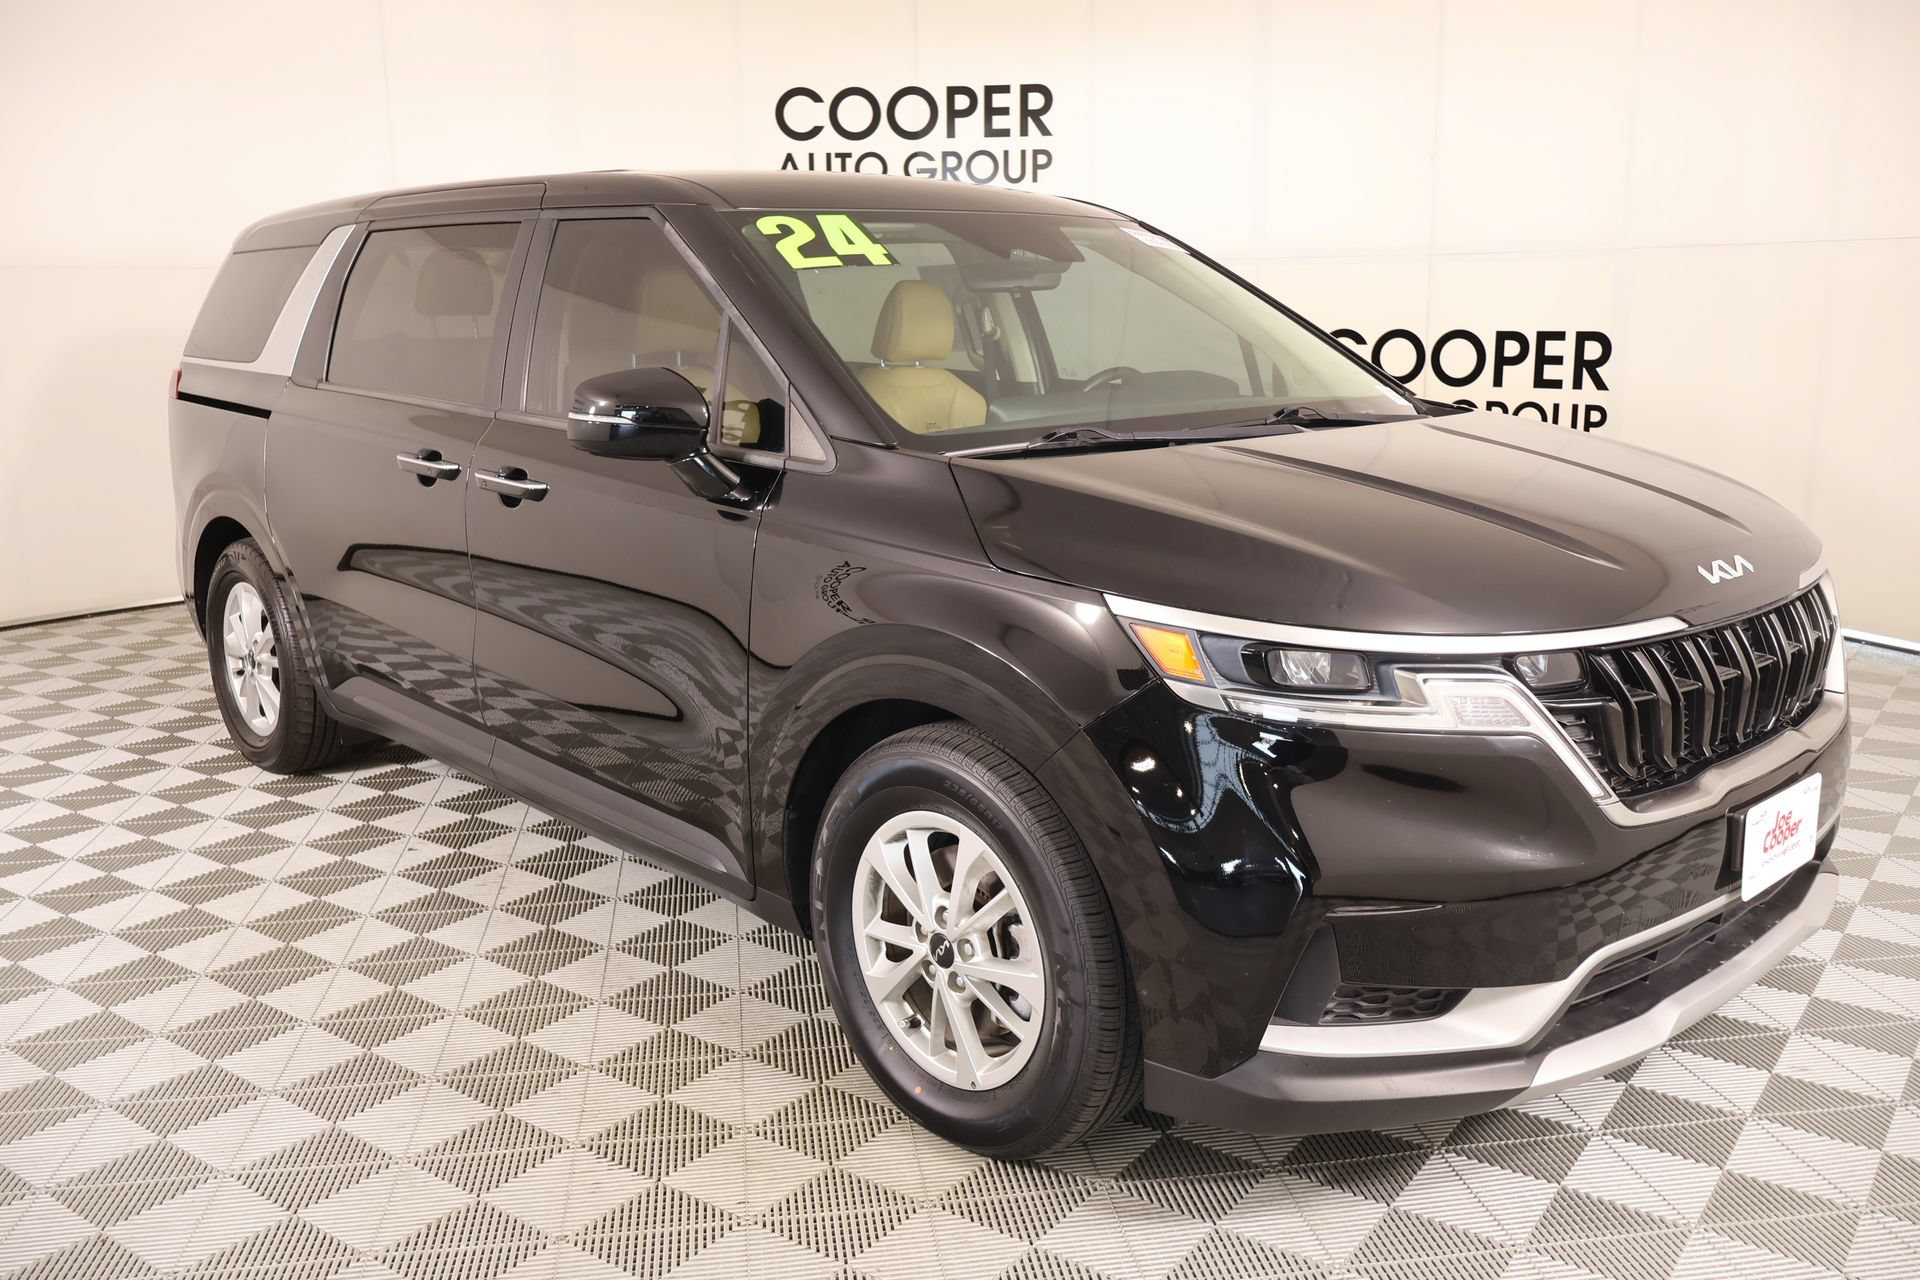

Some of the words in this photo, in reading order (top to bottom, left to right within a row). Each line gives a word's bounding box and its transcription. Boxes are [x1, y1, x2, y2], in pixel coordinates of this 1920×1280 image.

[775, 83, 1054, 141] COOPER
[903, 149, 1053, 184] GROUP
[755, 213, 895, 270] 24
[1763, 819, 1803, 854] Cooper
[1772, 809, 1793, 834] Joe
